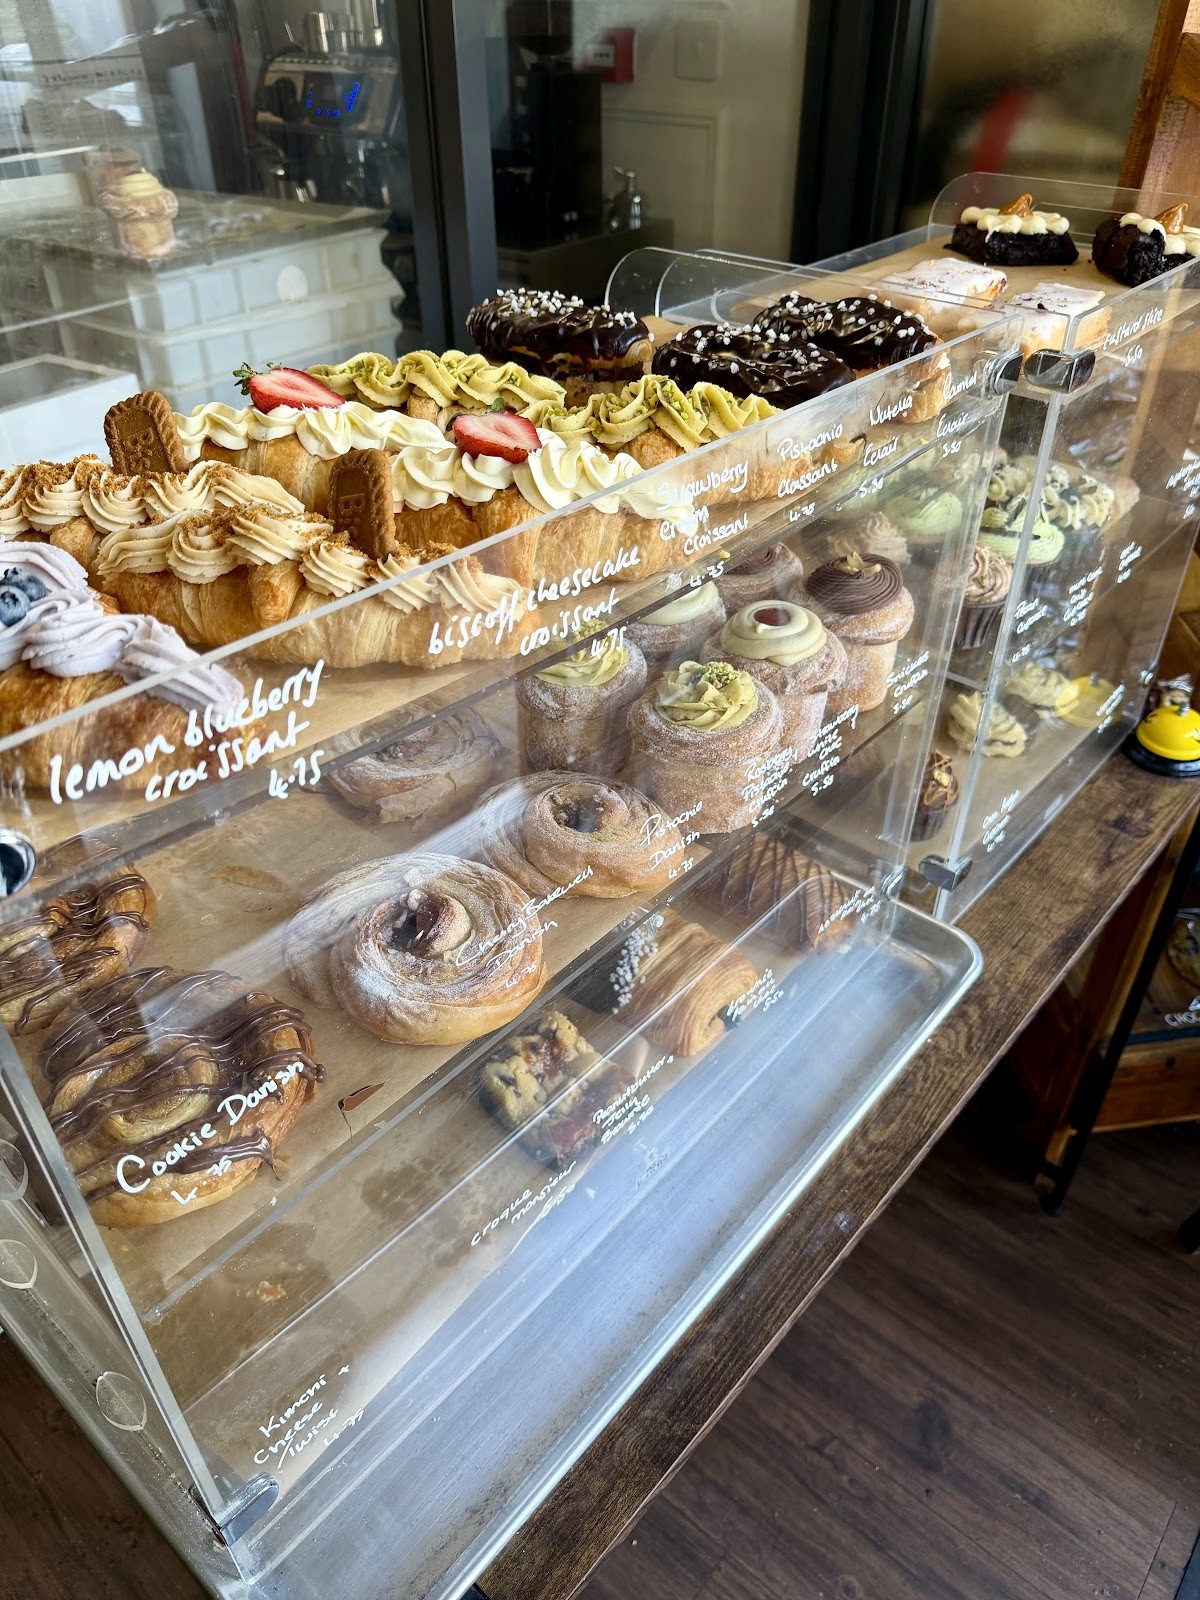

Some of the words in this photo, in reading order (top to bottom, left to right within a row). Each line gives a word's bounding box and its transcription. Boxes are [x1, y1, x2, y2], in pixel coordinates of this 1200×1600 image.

[683, 511, 749, 556] Croissant
[427, 588, 525, 655] biscoff
[526, 546, 642, 612] cheesecake
[519, 587, 621, 656] croissant
[49, 733, 176, 805] lemon
[183, 658, 326, 747] blueberry
[144, 710, 311, 802] croissant
[648, 830, 701, 872] Danish
[115, 1122, 218, 1194] Cookie
[216, 1061, 305, 1126] Danish
[470, 1188, 533, 1247] croque
[511, 1160, 577, 1225] monsieur
